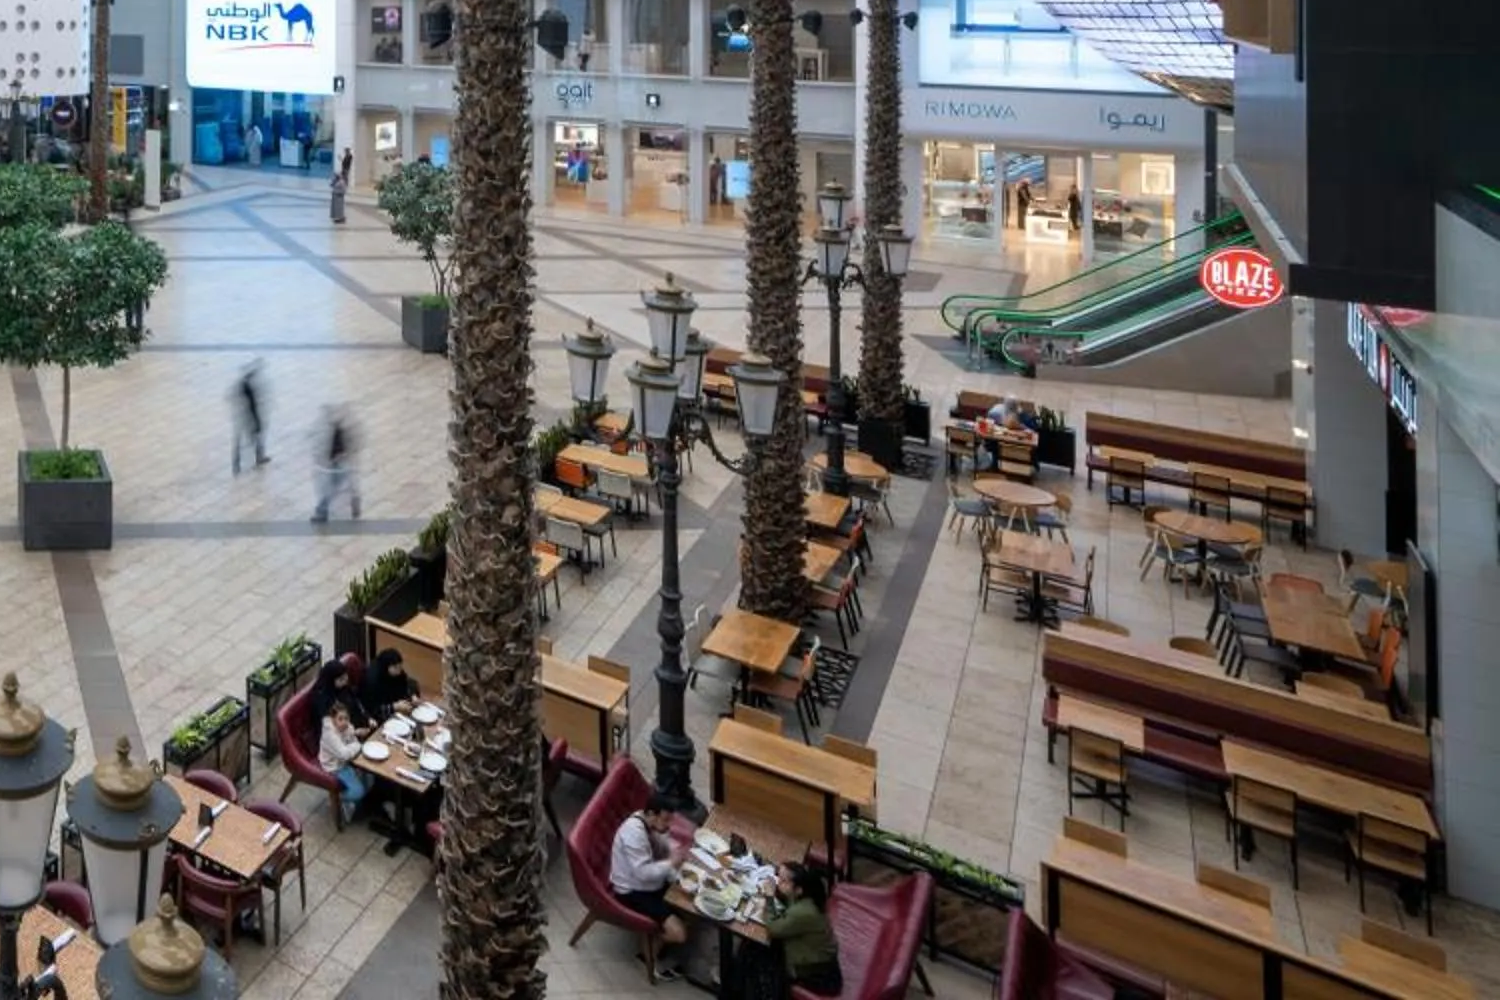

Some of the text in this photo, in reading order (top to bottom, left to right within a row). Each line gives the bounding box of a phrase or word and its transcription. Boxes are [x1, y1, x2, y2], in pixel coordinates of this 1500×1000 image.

[207, 1, 271, 23] الوطني
[206, 25, 268, 40] NBK
[925, 101, 1017, 120] RIMOWA
[1212, 261, 1274, 291] BLAZE
[1215, 285, 1271, 298] PIZZA
